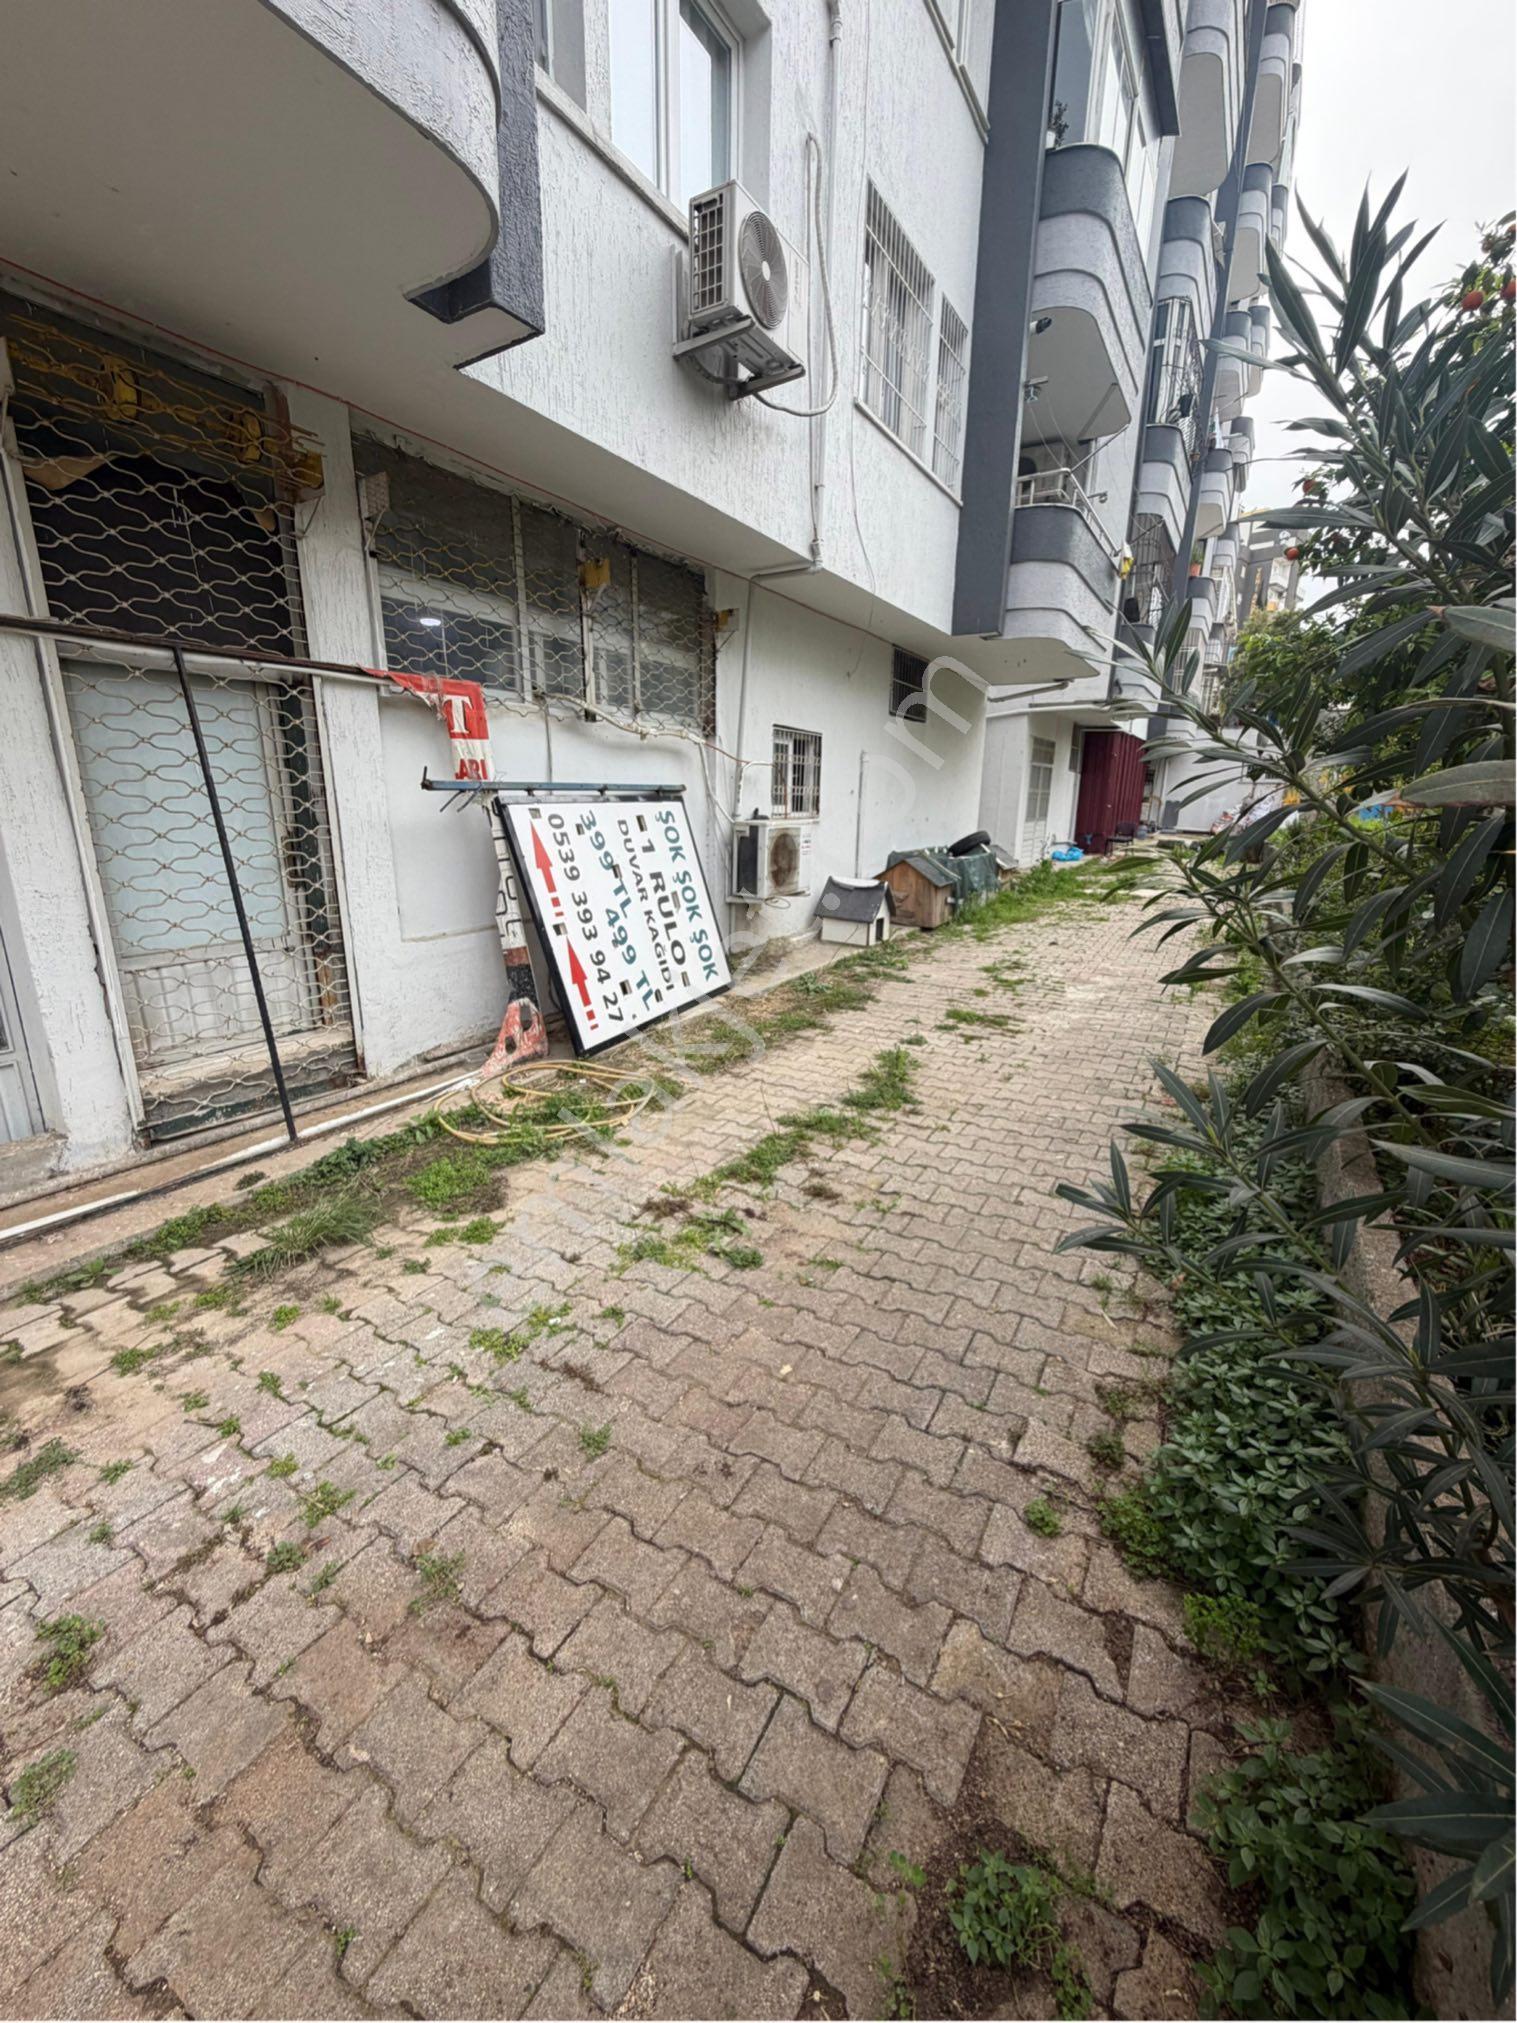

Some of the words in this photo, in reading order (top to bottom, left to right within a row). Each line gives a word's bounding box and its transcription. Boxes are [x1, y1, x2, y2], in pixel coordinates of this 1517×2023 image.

[455, 758, 488, 780] ARI
[580, 809, 614, 871] 399
[547, 813, 581, 881] 0539
[571, 891, 598, 941] 393
[590, 950, 611, 985] 94
[602, 991, 624, 1022] 27
[613, 877, 632, 919] TL
[617, 819, 648, 902] DUVAR
[644, 910, 674, 990] KAĞIDI
[642, 838, 655, 853] 1
[649, 871, 686, 965] RULO
[655, 810, 687, 862] ŞOK
[672, 870, 703, 922] ŞOK
[690, 928, 719, 981] ŞOK
[605, 908, 637, 965] 499
[636, 969, 653, 1011] TL
